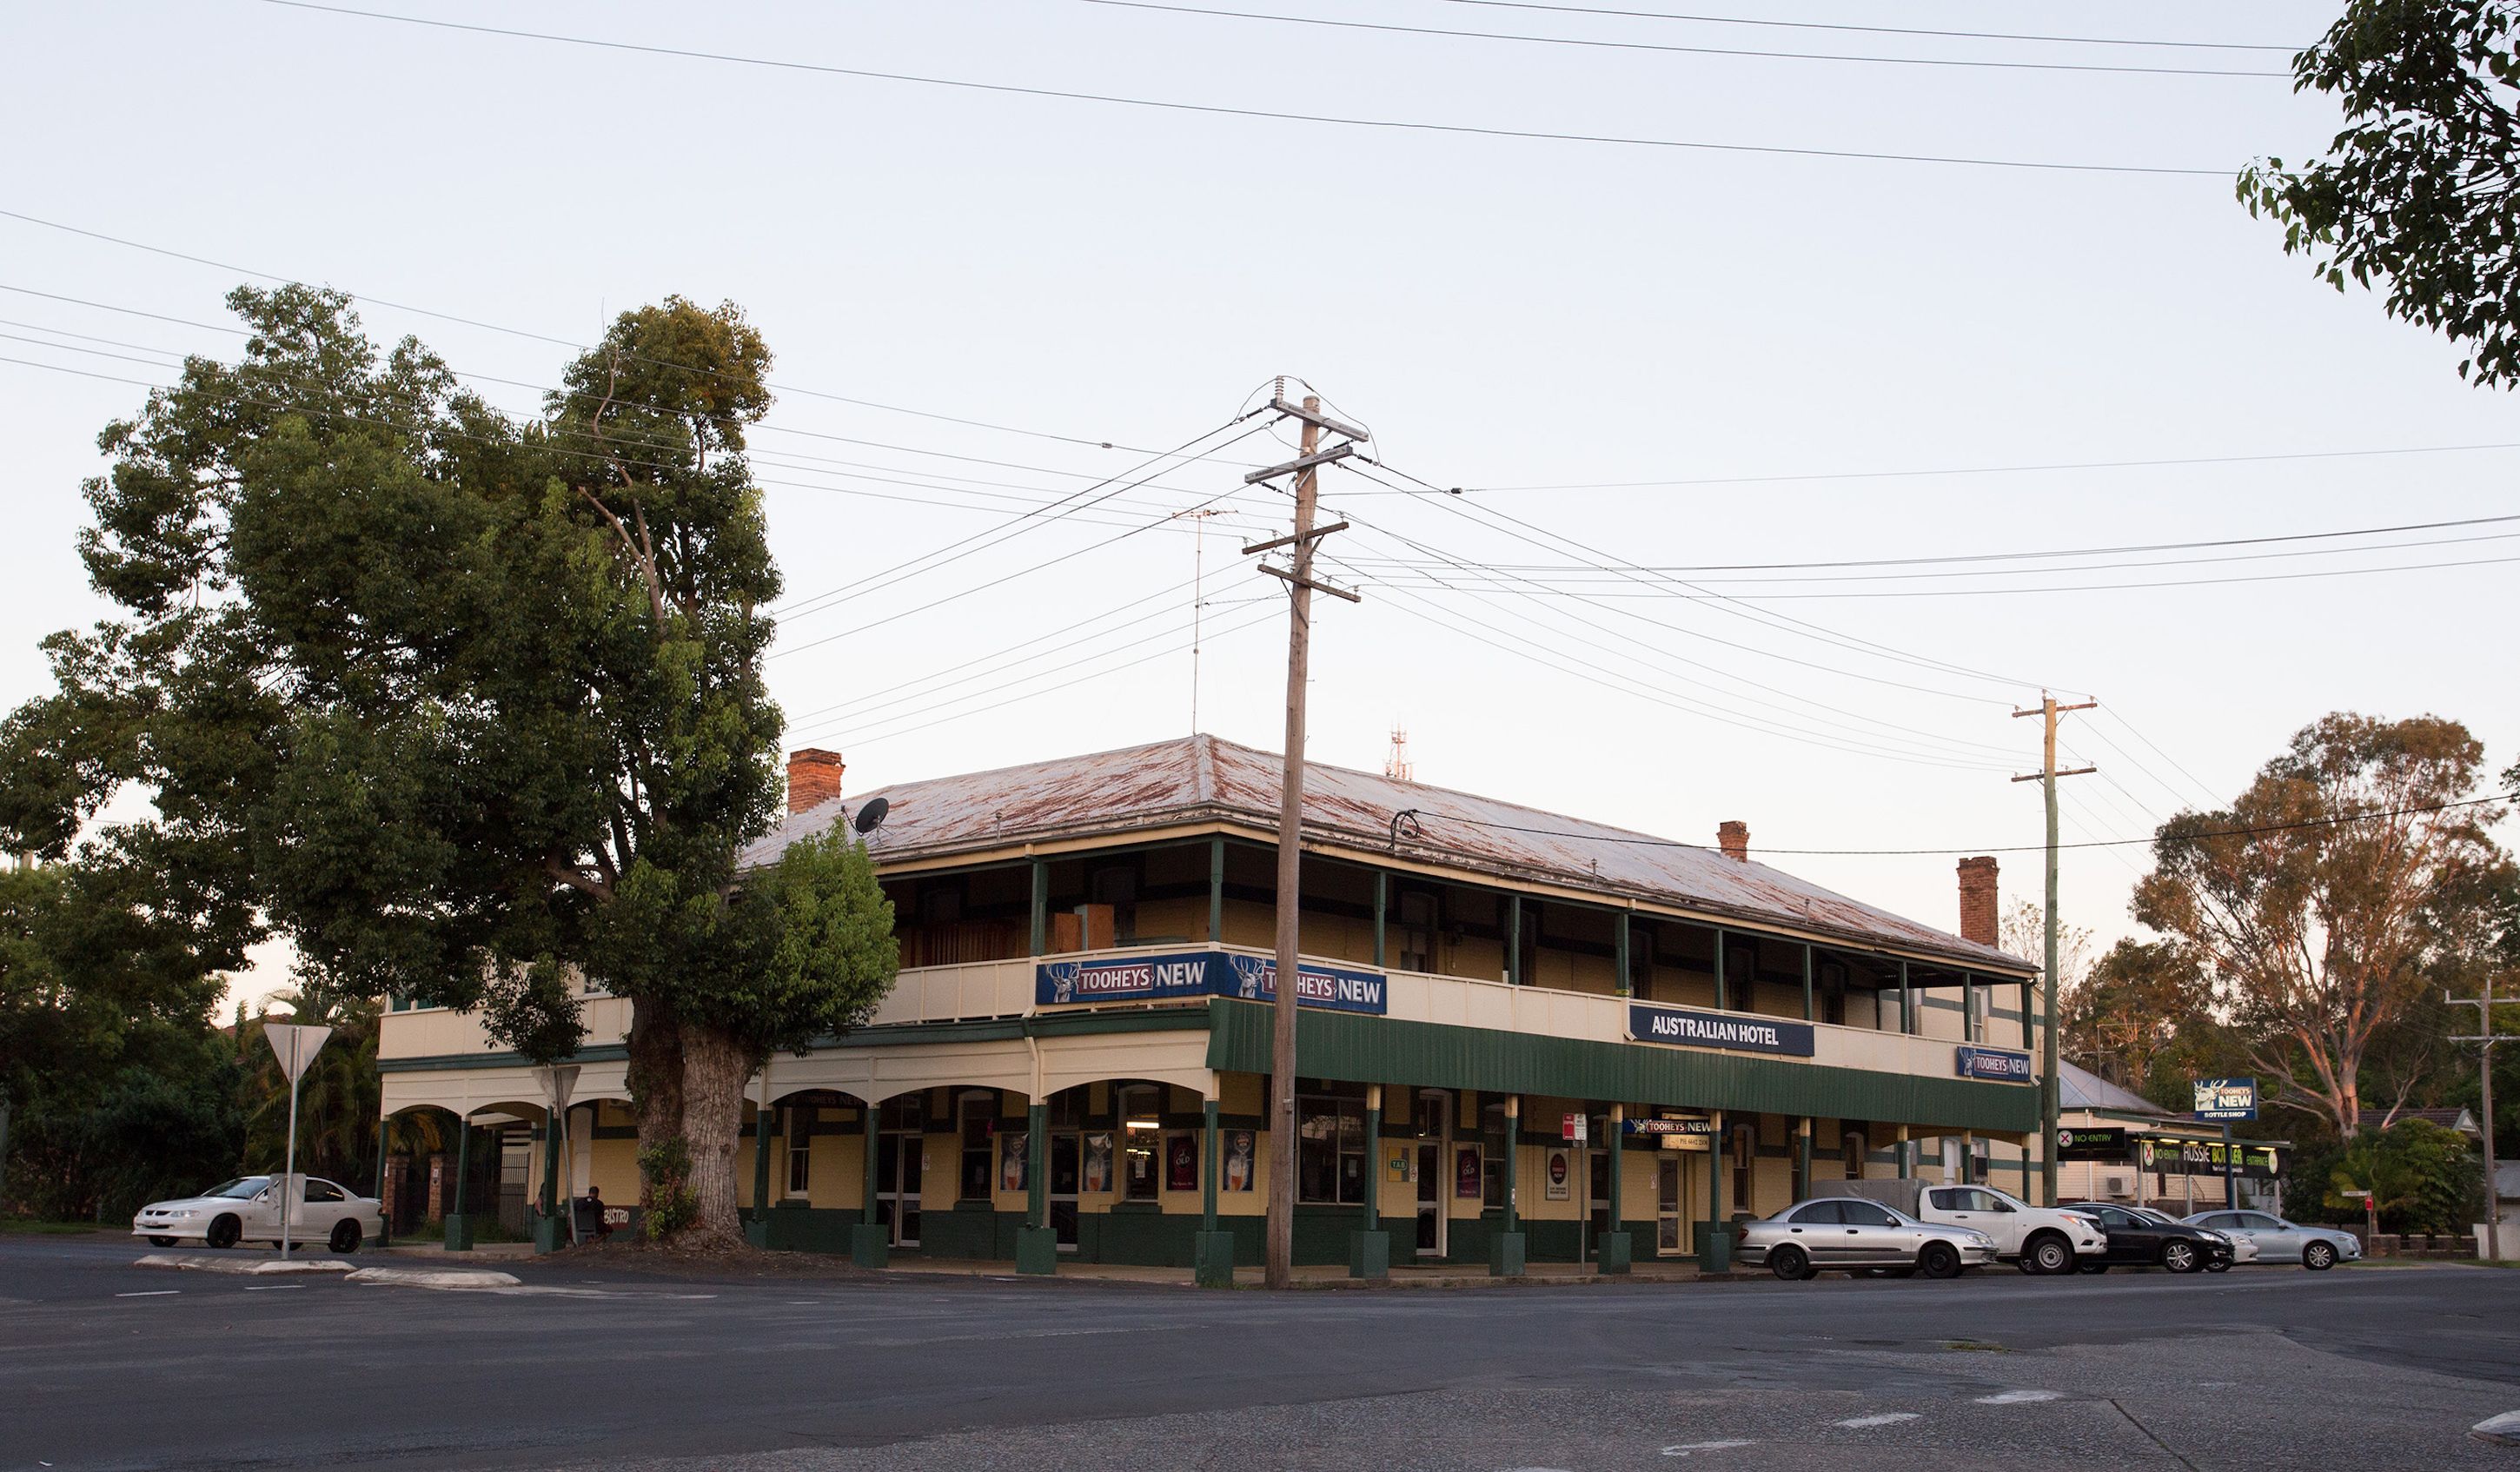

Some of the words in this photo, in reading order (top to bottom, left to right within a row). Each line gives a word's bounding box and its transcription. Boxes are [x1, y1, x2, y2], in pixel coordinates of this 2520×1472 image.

[1081, 969, 1148, 990] TOOHEYS
[1156, 961, 1206, 987] NEW
[1265, 971, 1332, 997] THEYS
[1338, 978, 1381, 1005] NEW
[1652, 1015, 1737, 1041] AUSTRALIAN
[1739, 1024, 1779, 1045] HOTEL
[1976, 1056, 2007, 1071] TOOHEYS
[2009, 1058, 2030, 1074] NEW
[2218, 1095, 2252, 1107] NEW
[1648, 1123, 1685, 1131] TOOHEYS
[1688, 1122, 1711, 1132] NEW
[2074, 1134, 2086, 1143] NO
[2088, 1133, 2112, 1143] ENTRY
[2154, 1148, 2164, 1159] NO
[2164, 1149, 2179, 1161] ENTRY
[2183, 1145, 2211, 1163] AUSSIE
[2245, 1155, 2268, 1166] ENTRANCE
[603, 1208, 629, 1224] BISTRO
